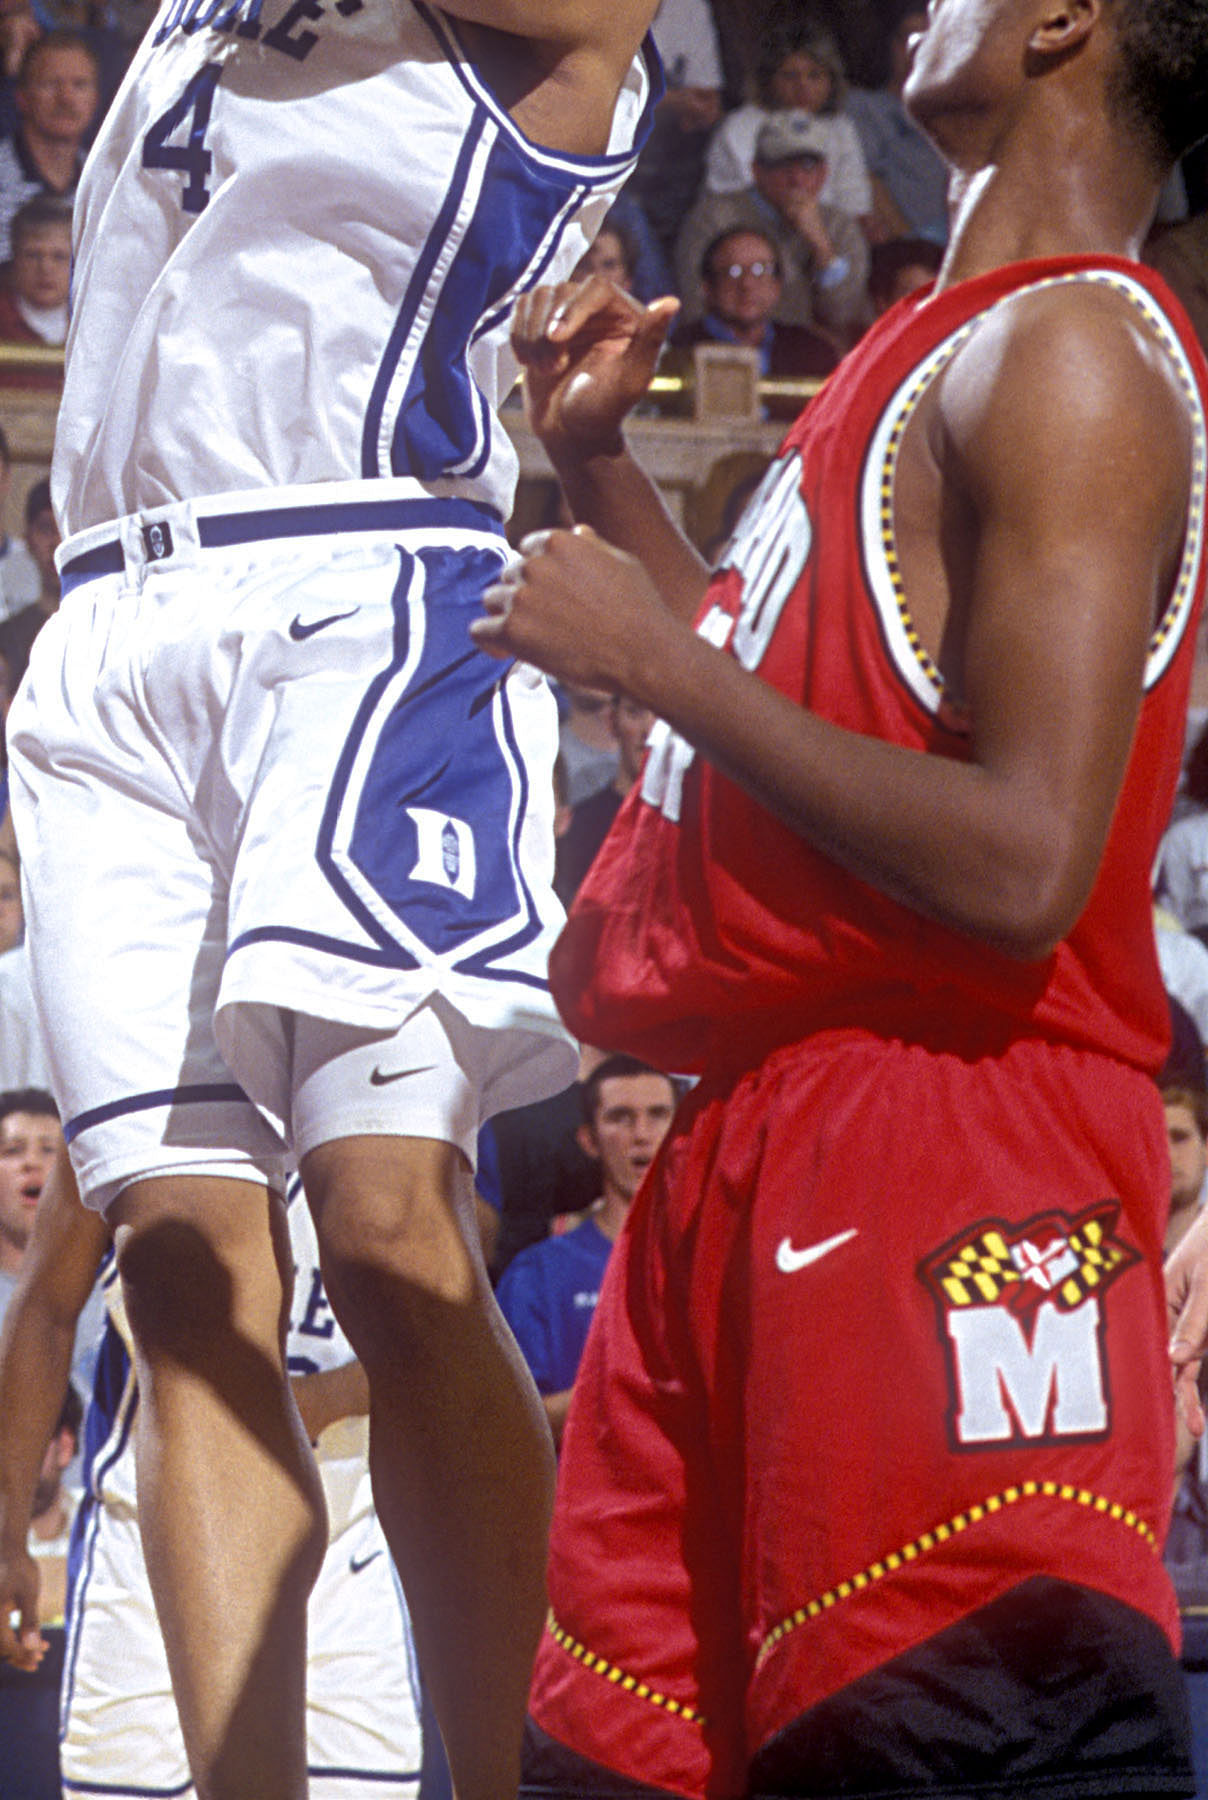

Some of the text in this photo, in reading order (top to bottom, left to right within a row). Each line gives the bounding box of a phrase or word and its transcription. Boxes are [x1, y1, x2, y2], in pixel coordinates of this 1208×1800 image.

[142, 62, 223, 214] 4
[405, 808, 476, 901] D
[949, 1298, 1107, 1443] M
